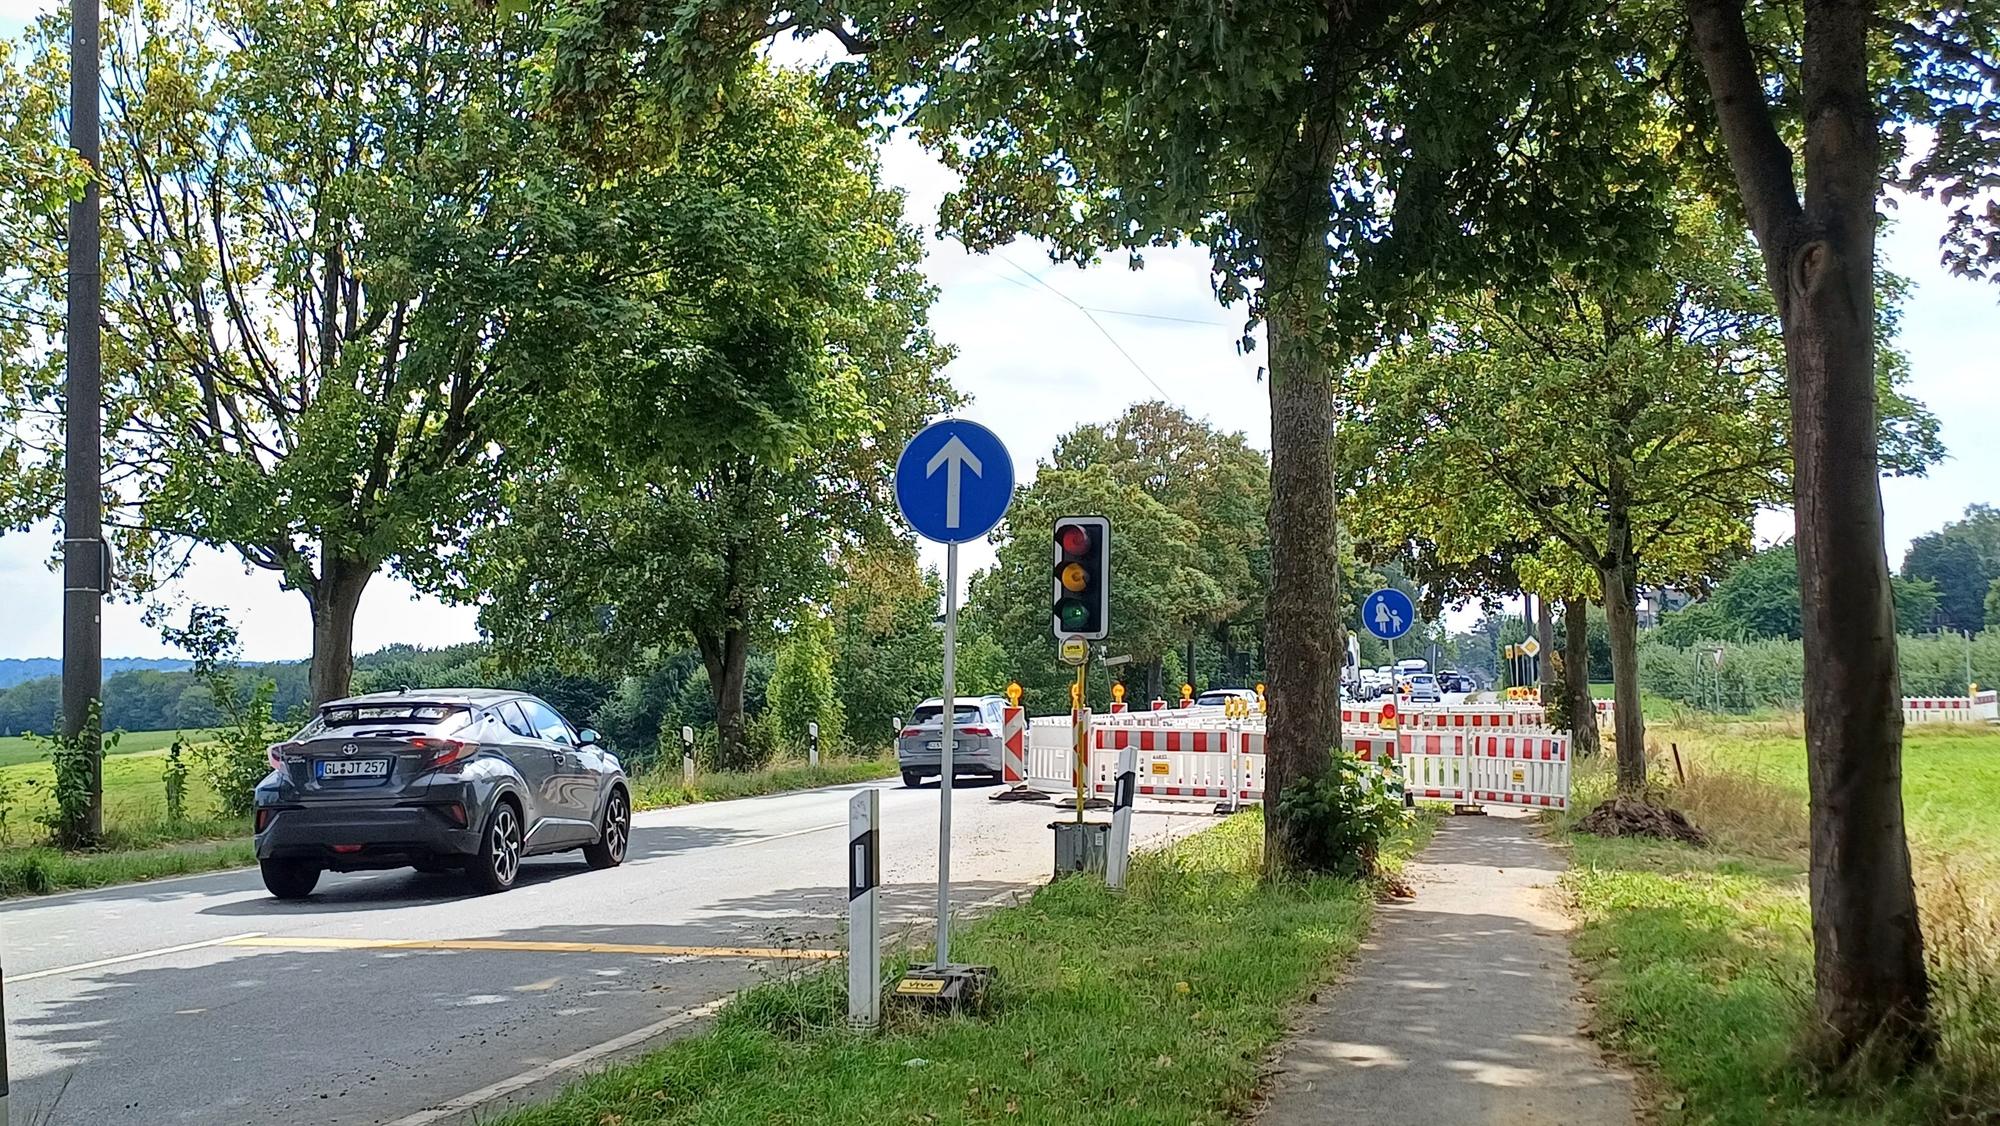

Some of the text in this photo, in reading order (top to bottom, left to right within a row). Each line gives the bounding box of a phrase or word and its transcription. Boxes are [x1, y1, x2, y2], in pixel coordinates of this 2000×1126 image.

[325, 762, 385, 774] GL JT 257
